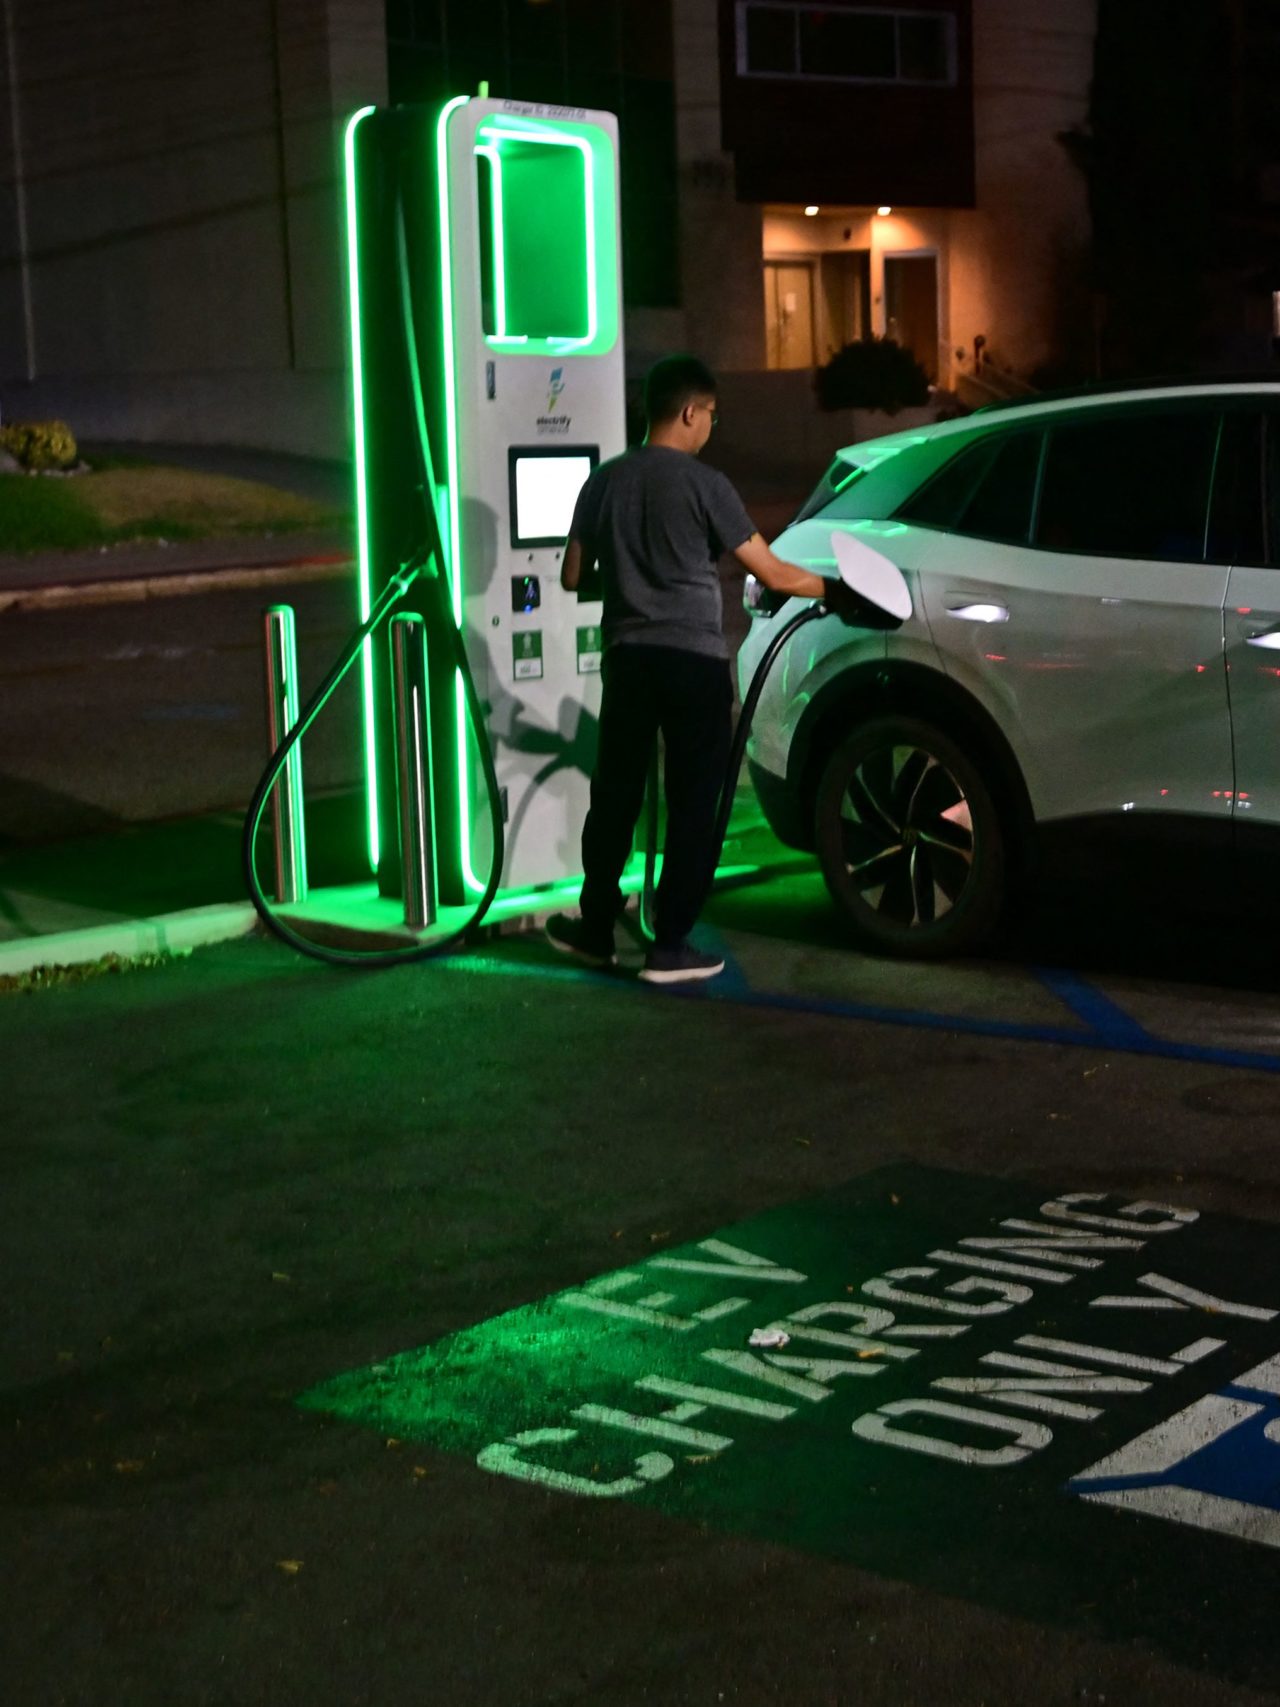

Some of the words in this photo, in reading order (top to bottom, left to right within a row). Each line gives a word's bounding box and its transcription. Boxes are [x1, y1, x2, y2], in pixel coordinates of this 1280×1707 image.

[536, 415, 571, 428] electrify
[476, 1192, 1200, 1498] CHARGING
[554, 1238, 808, 1331] EV
[851, 1271, 1280, 1467] ONLY
